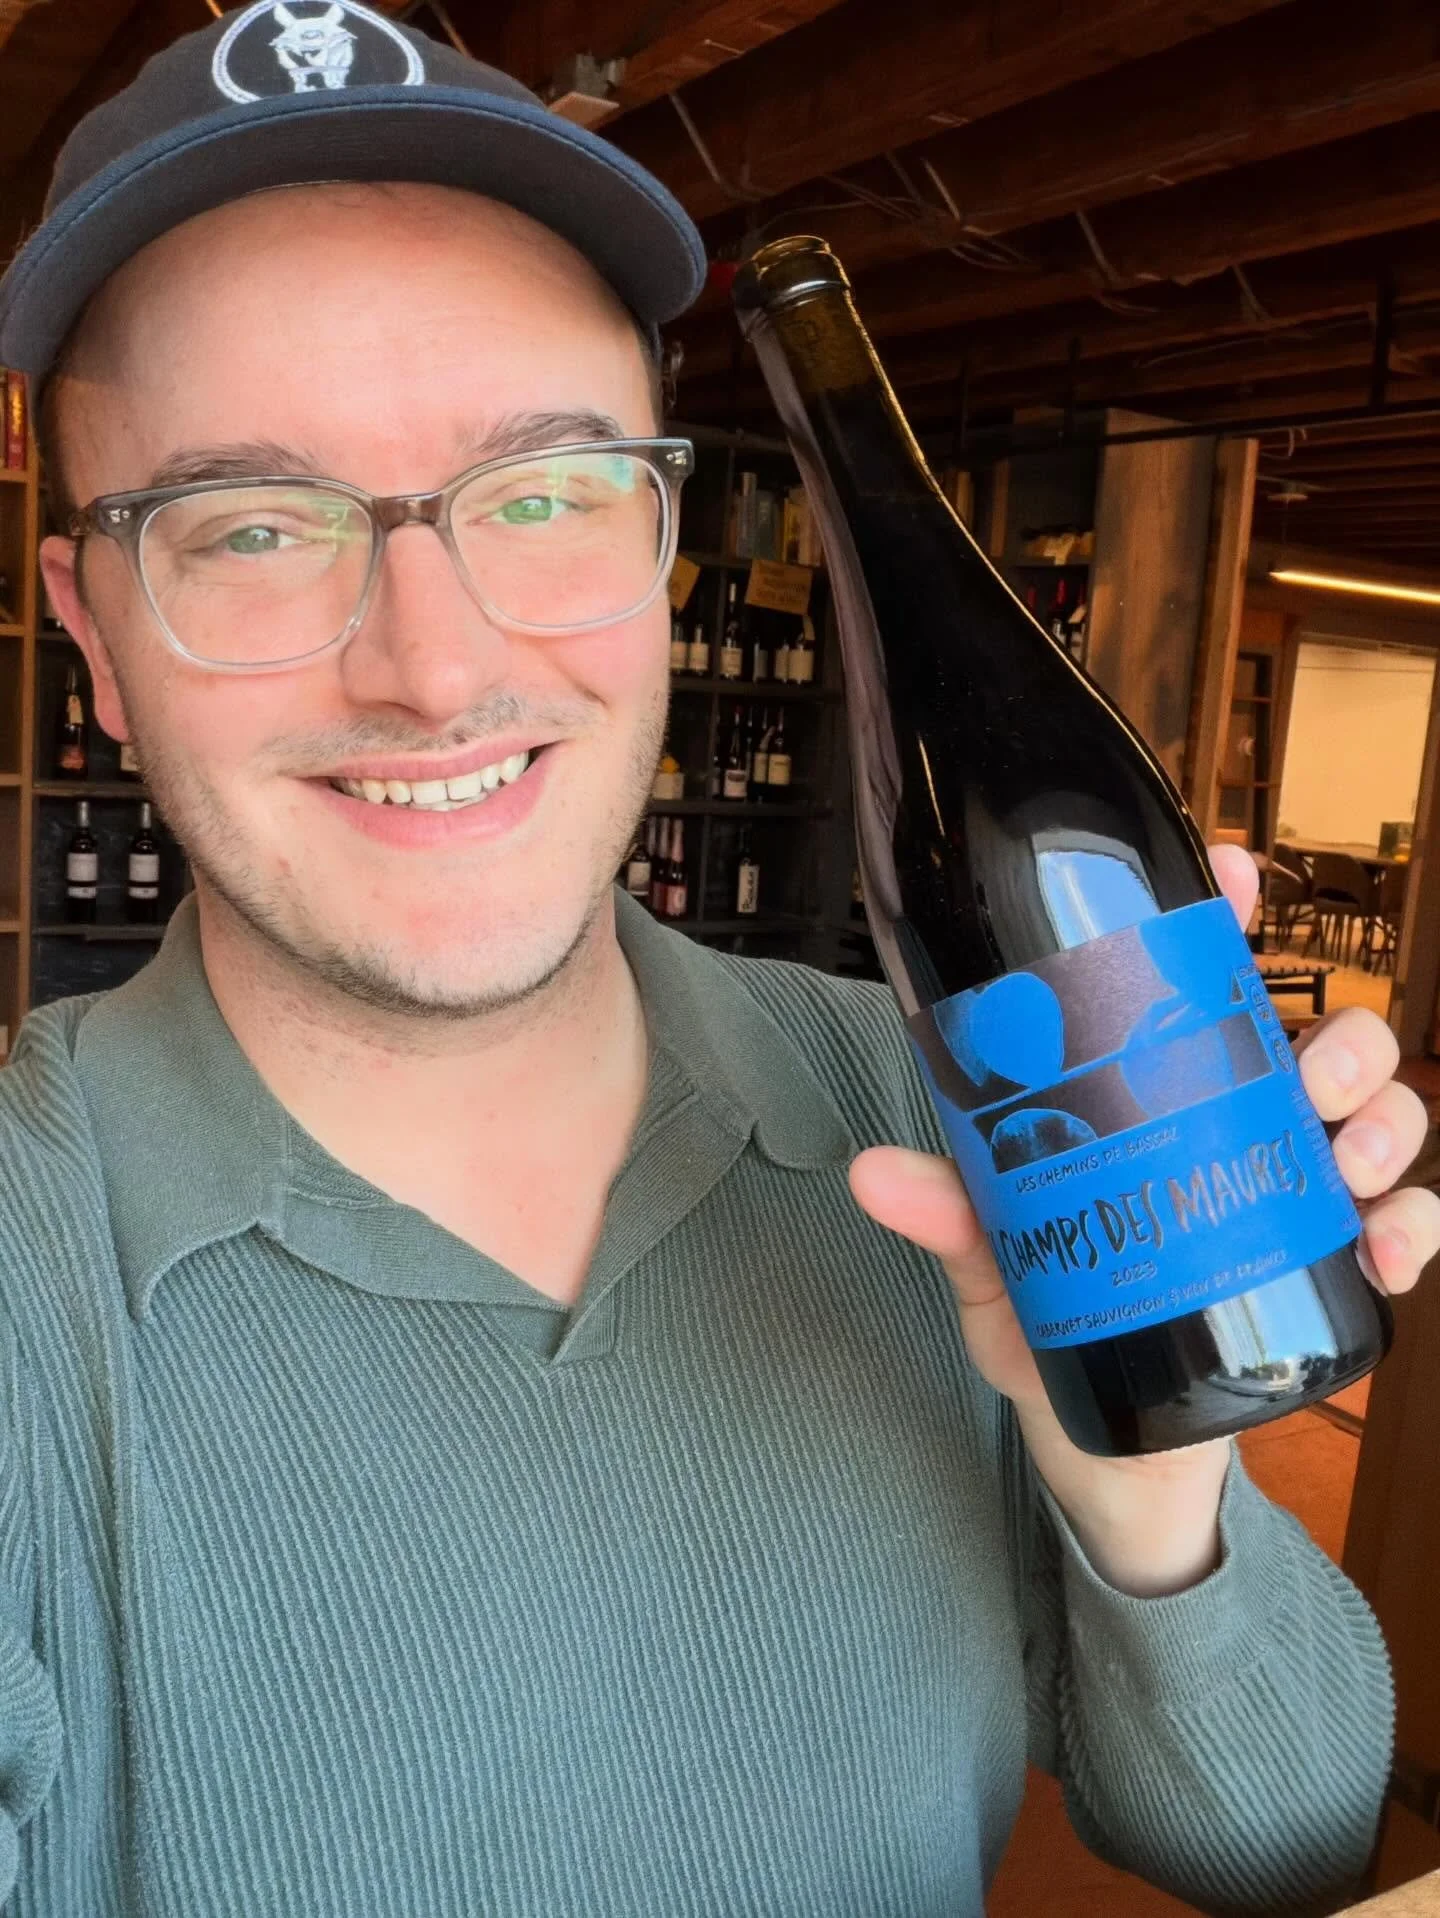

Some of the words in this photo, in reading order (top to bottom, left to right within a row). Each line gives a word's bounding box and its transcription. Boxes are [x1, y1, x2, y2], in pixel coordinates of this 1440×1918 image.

[1016, 1174, 1037, 1193] LES
[1038, 1153, 1100, 1187] CHEMINS
[1103, 1145, 1121, 1167] DE
[999, 1209, 1099, 1282] CHAMPS
[1093, 1180, 1163, 1254] DES
[1166, 1128, 1308, 1233] MAURES
[1111, 1260, 1157, 1287] 2023
[1086, 1293, 1165, 1331] SAUVIGNON
